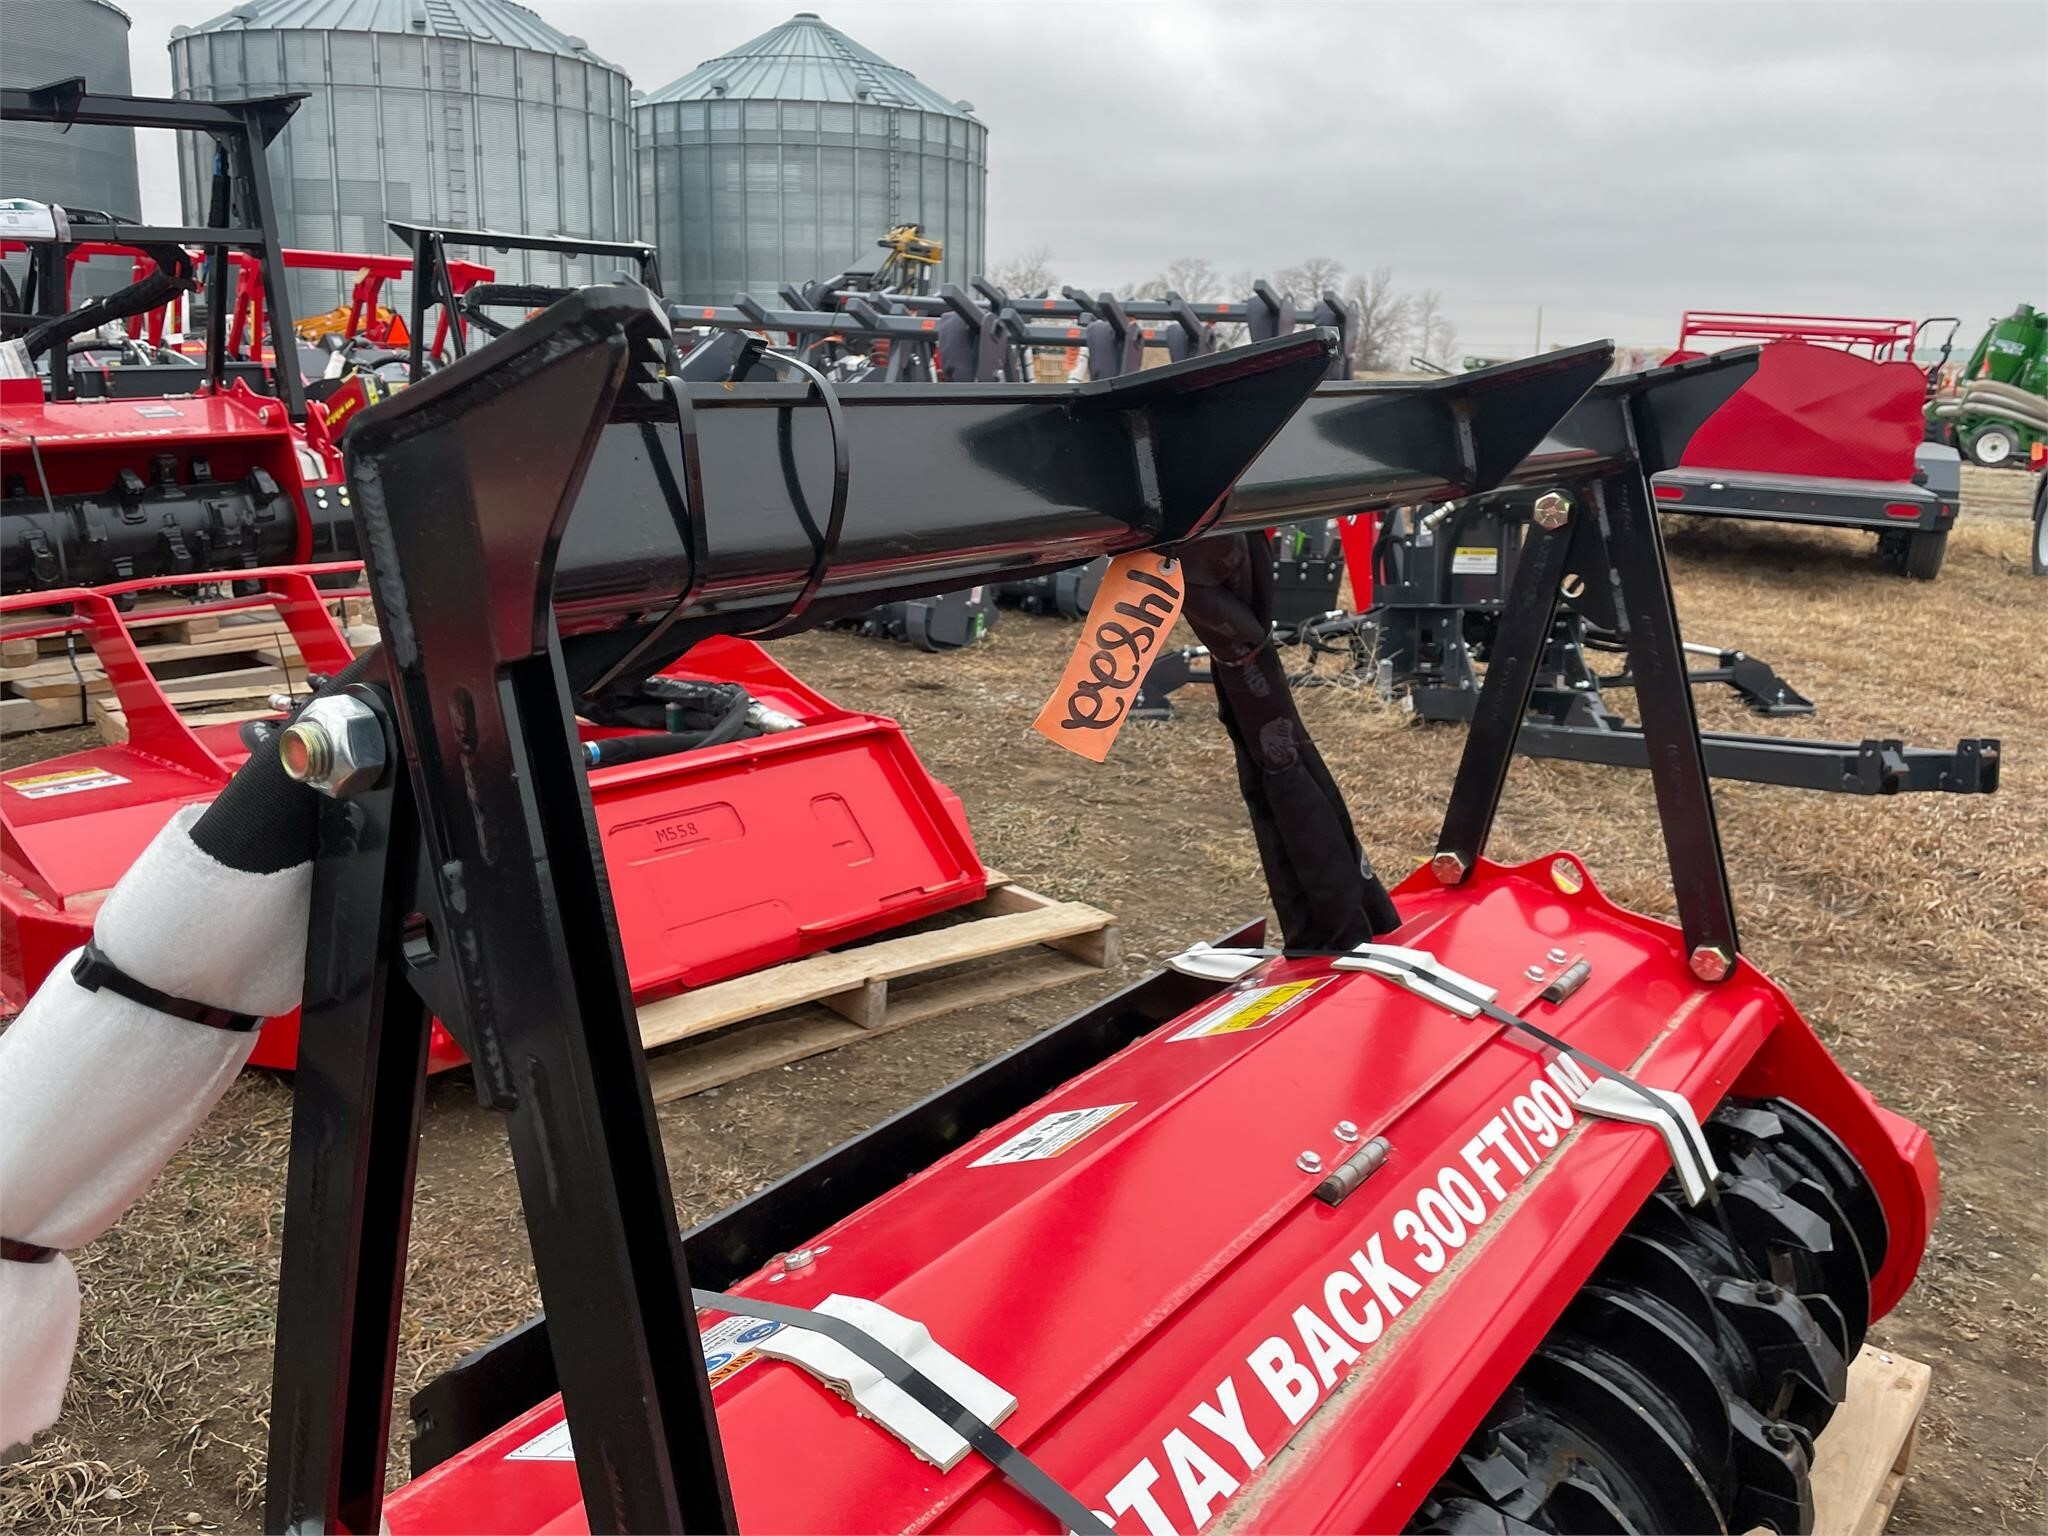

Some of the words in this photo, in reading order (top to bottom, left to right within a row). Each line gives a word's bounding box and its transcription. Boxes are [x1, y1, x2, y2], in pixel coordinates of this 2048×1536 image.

[655, 822, 699, 844] M558
[1090, 1375, 1266, 1536] TAY
[1245, 1231, 1423, 1426] BACK
[1393, 1167, 1487, 1273] 300
[1459, 1079, 1575, 1202] FT/90
